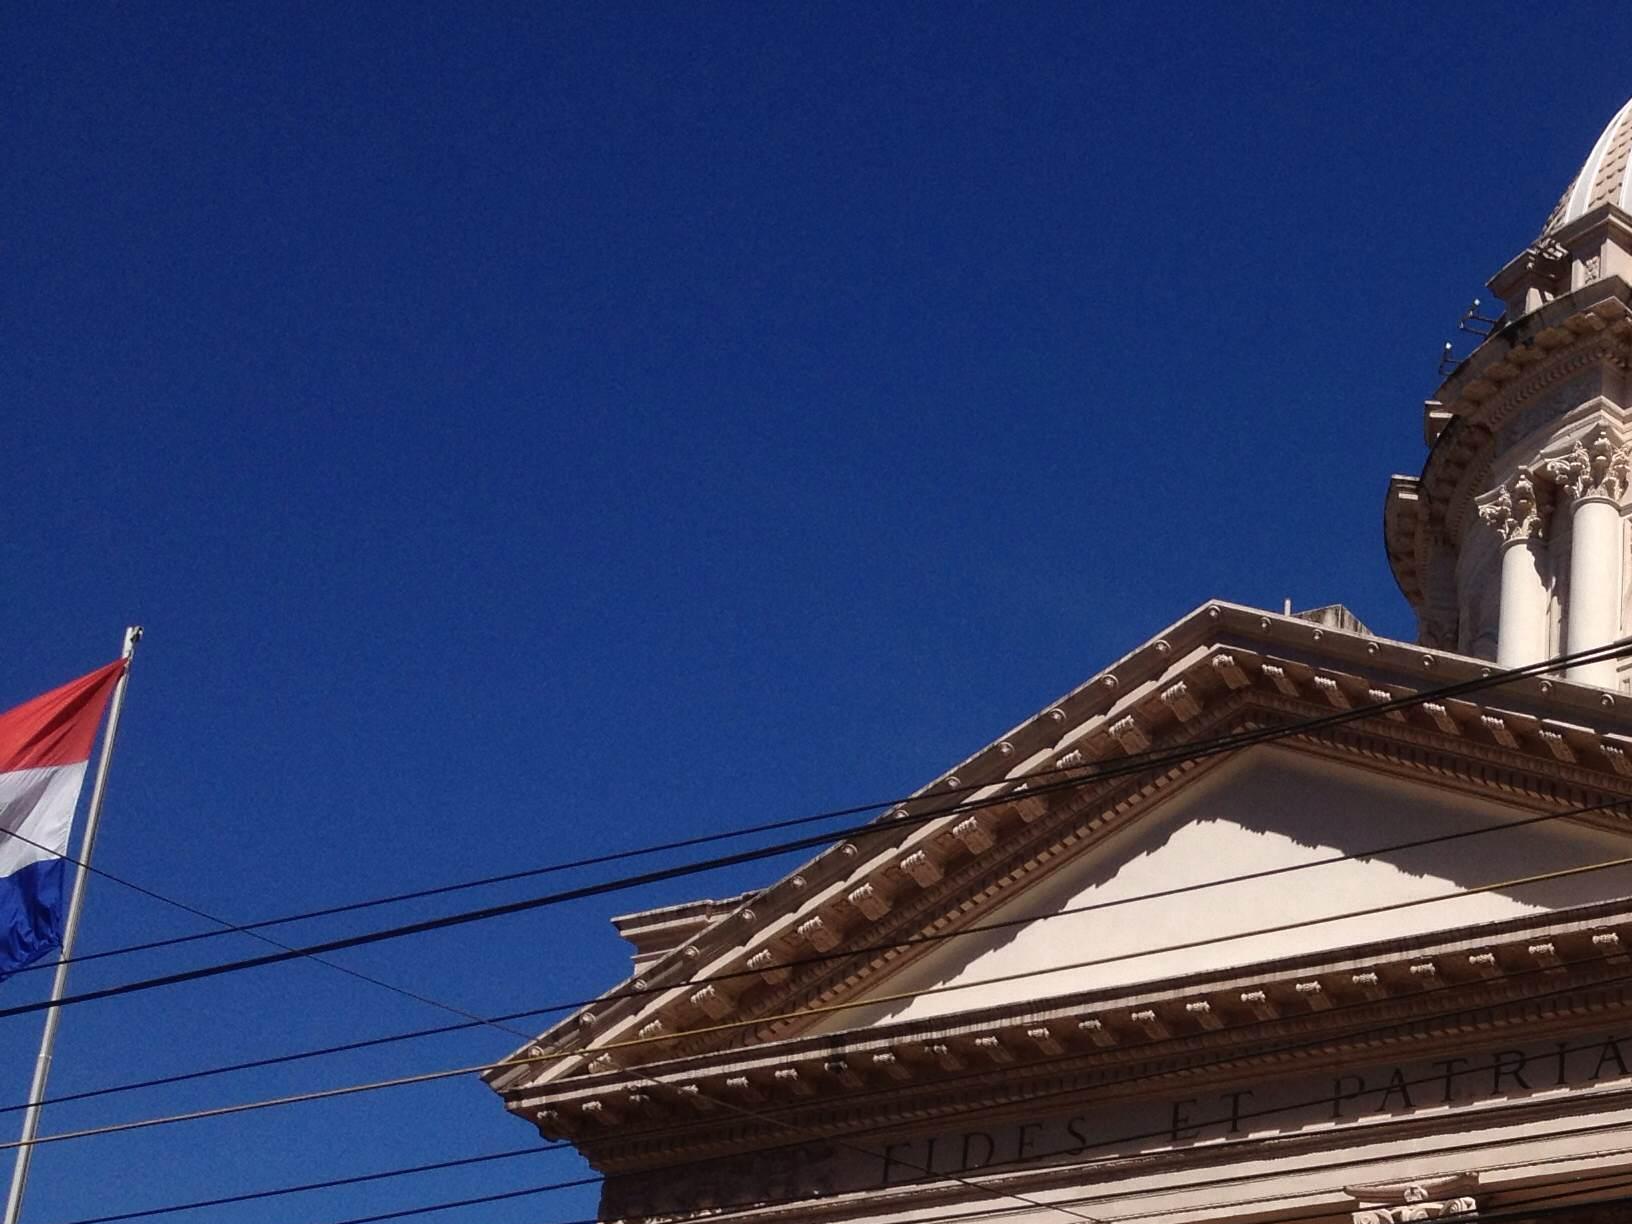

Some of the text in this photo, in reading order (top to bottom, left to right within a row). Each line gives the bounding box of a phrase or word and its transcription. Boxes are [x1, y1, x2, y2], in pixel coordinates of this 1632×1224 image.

[881, 1035, 1632, 1184] FIDES ET PATRIA
